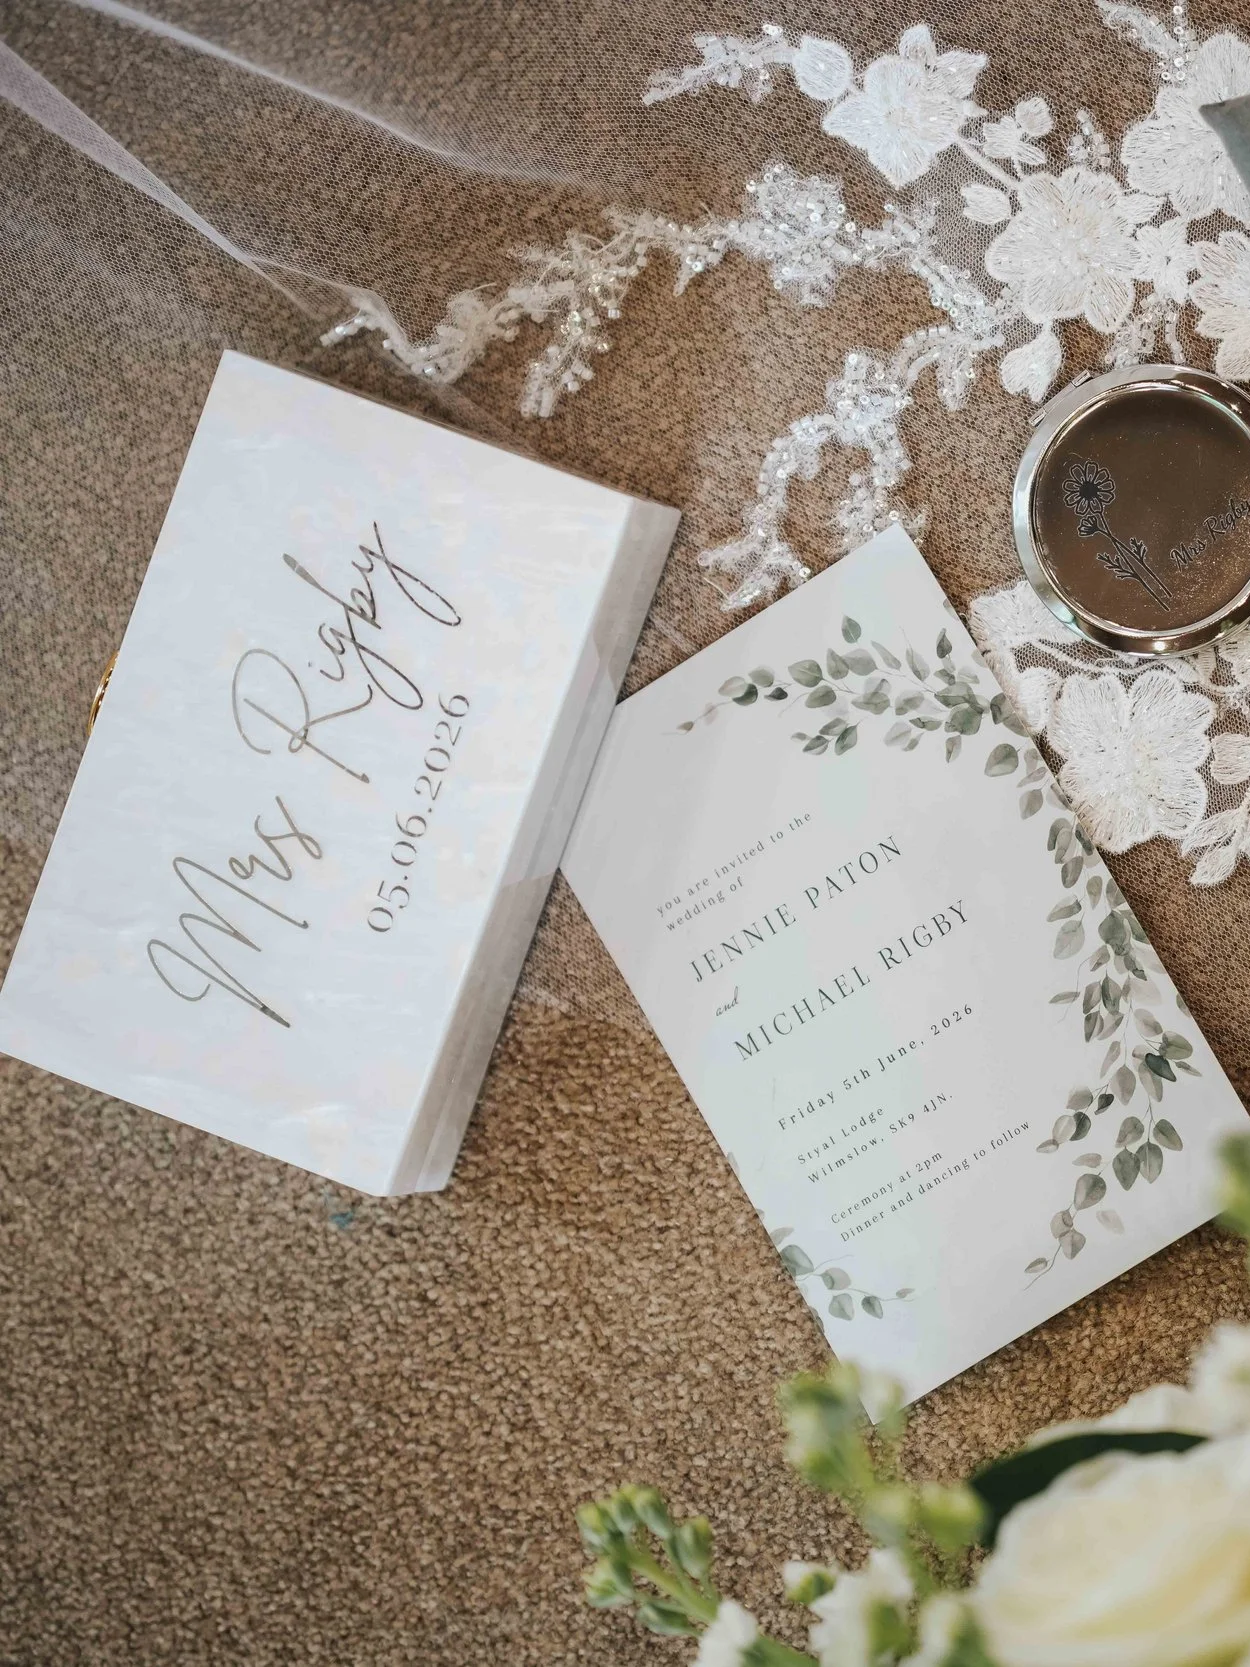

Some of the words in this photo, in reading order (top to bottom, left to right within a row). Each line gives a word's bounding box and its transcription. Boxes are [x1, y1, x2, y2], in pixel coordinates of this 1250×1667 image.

[1169, 537, 1206, 572] Mrs
[231, 520, 463, 785] Rigby
[366, 694, 470, 933] 05.06.2026
[656, 895, 682, 918] you
[687, 878, 710, 897] are
[713, 840, 765, 879] invited
[769, 831, 784, 844] to
[788, 813, 811, 832] the
[146, 795, 324, 1029] Mrs
[666, 889, 726, 932] wedding
[729, 875, 743, 892] of
[689, 903, 798, 983] JENNIE
[802, 834, 902, 911] PATON
[715, 985, 739, 1017] and
[733, 965, 871, 1062] MICHAEL
[876, 899, 968, 972] RIGBY
[777, 1090, 835, 1131] Friday
[842, 1068, 872, 1091] 5th
[876, 1040, 925, 1073] June,
[930, 1003, 973, 1036] 2026
[888, 1112, 915, 1134] SK9
[797, 1135, 836, 1165] Styal
[840, 1108, 884, 1138] Lodge
[830, 1181, 894, 1224] Ceremony
[898, 1170, 912, 1184] at
[915, 1152, 943, 1173] 2pm
[840, 1211, 885, 1243] Dinner
[890, 1191, 914, 1213] and
[918, 1158, 971, 1195] dancing
[972, 1149, 986, 1161] to
[990, 1121, 1030, 1151] follow
